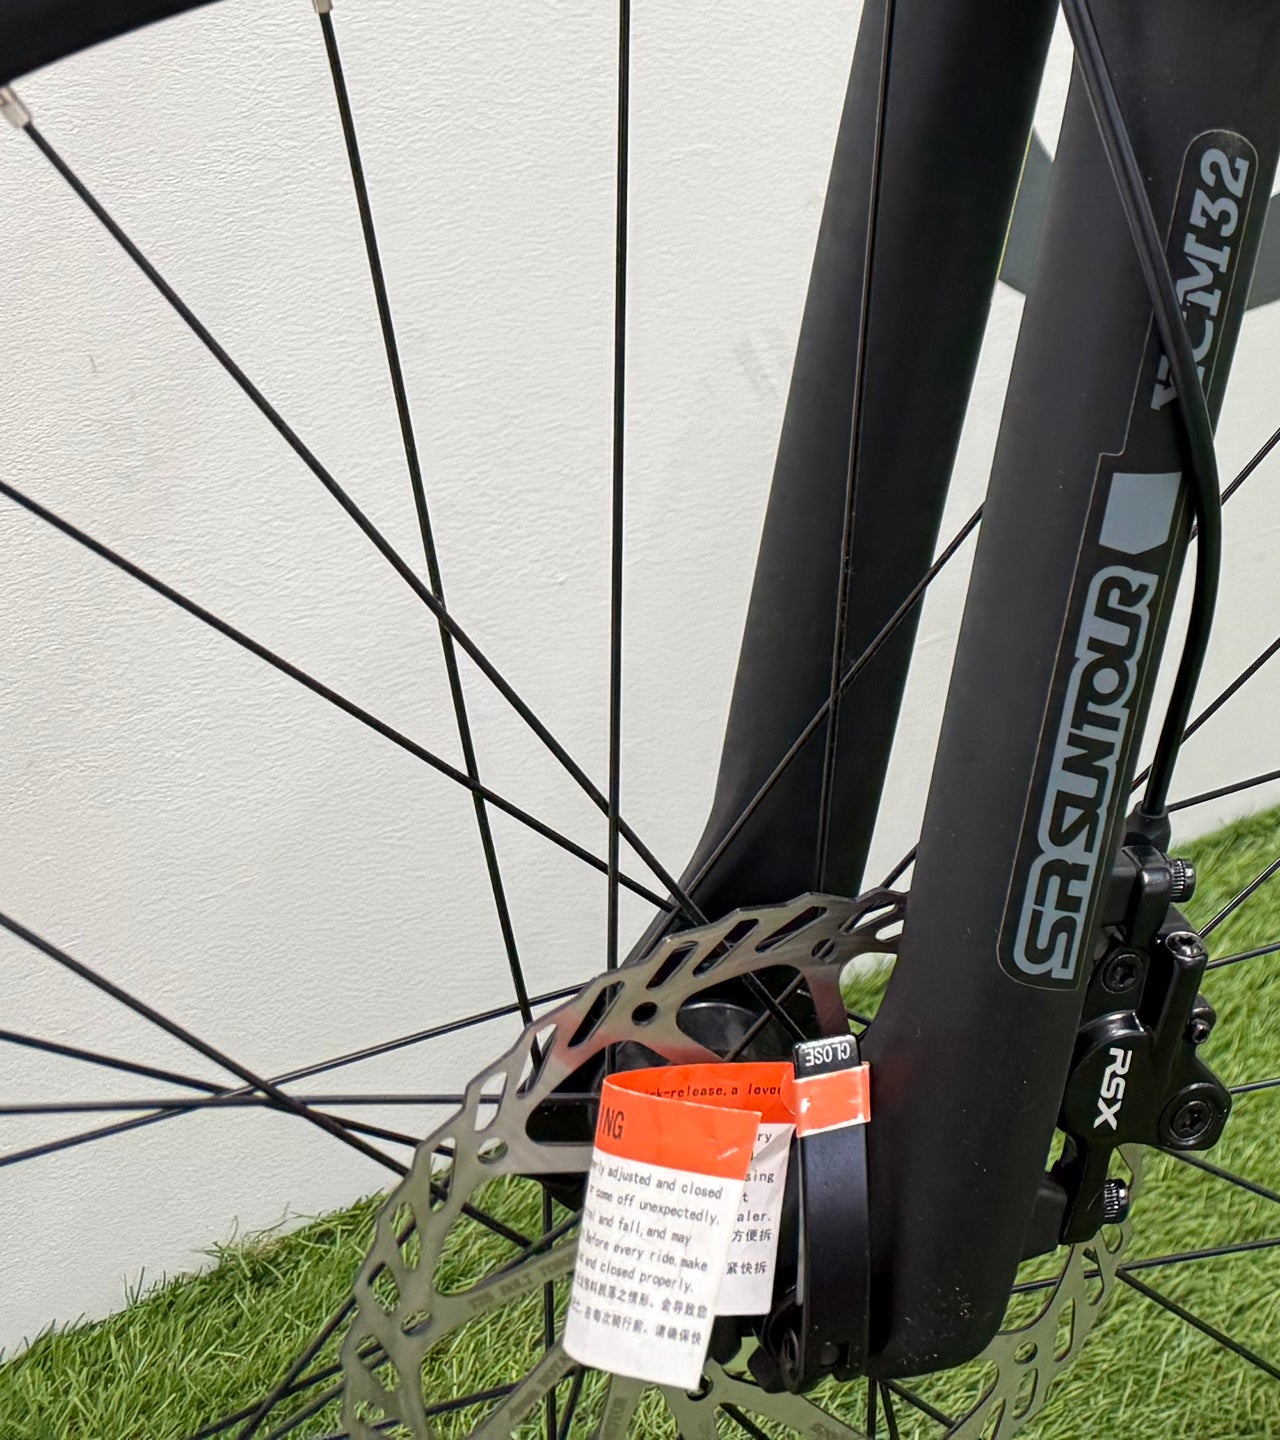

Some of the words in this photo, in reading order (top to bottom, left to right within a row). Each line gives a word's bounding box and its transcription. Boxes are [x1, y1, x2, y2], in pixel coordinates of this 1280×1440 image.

[1048, 574, 1149, 854] SUNTOUR
[805, 1042, 851, 1066] CLOSE
[1093, 1046, 1133, 1131] RSX
[608, 1166, 651, 1187] adjusted
[656, 1178, 676, 1192] and
[681, 1181, 723, 1200] closed
[617, 1193, 635, 1207] off
[639, 1202, 720, 1226] unexpectedly.
[737, 1210, 772, 1223] aler.
[646, 1226, 666, 1240] and
[671, 1232, 691, 1247] may
[613, 1242, 644, 1261] every
[680, 1257, 708, 1272] make
[600, 1261, 636, 1280] closed
[639, 1271, 694, 1294] properly.
